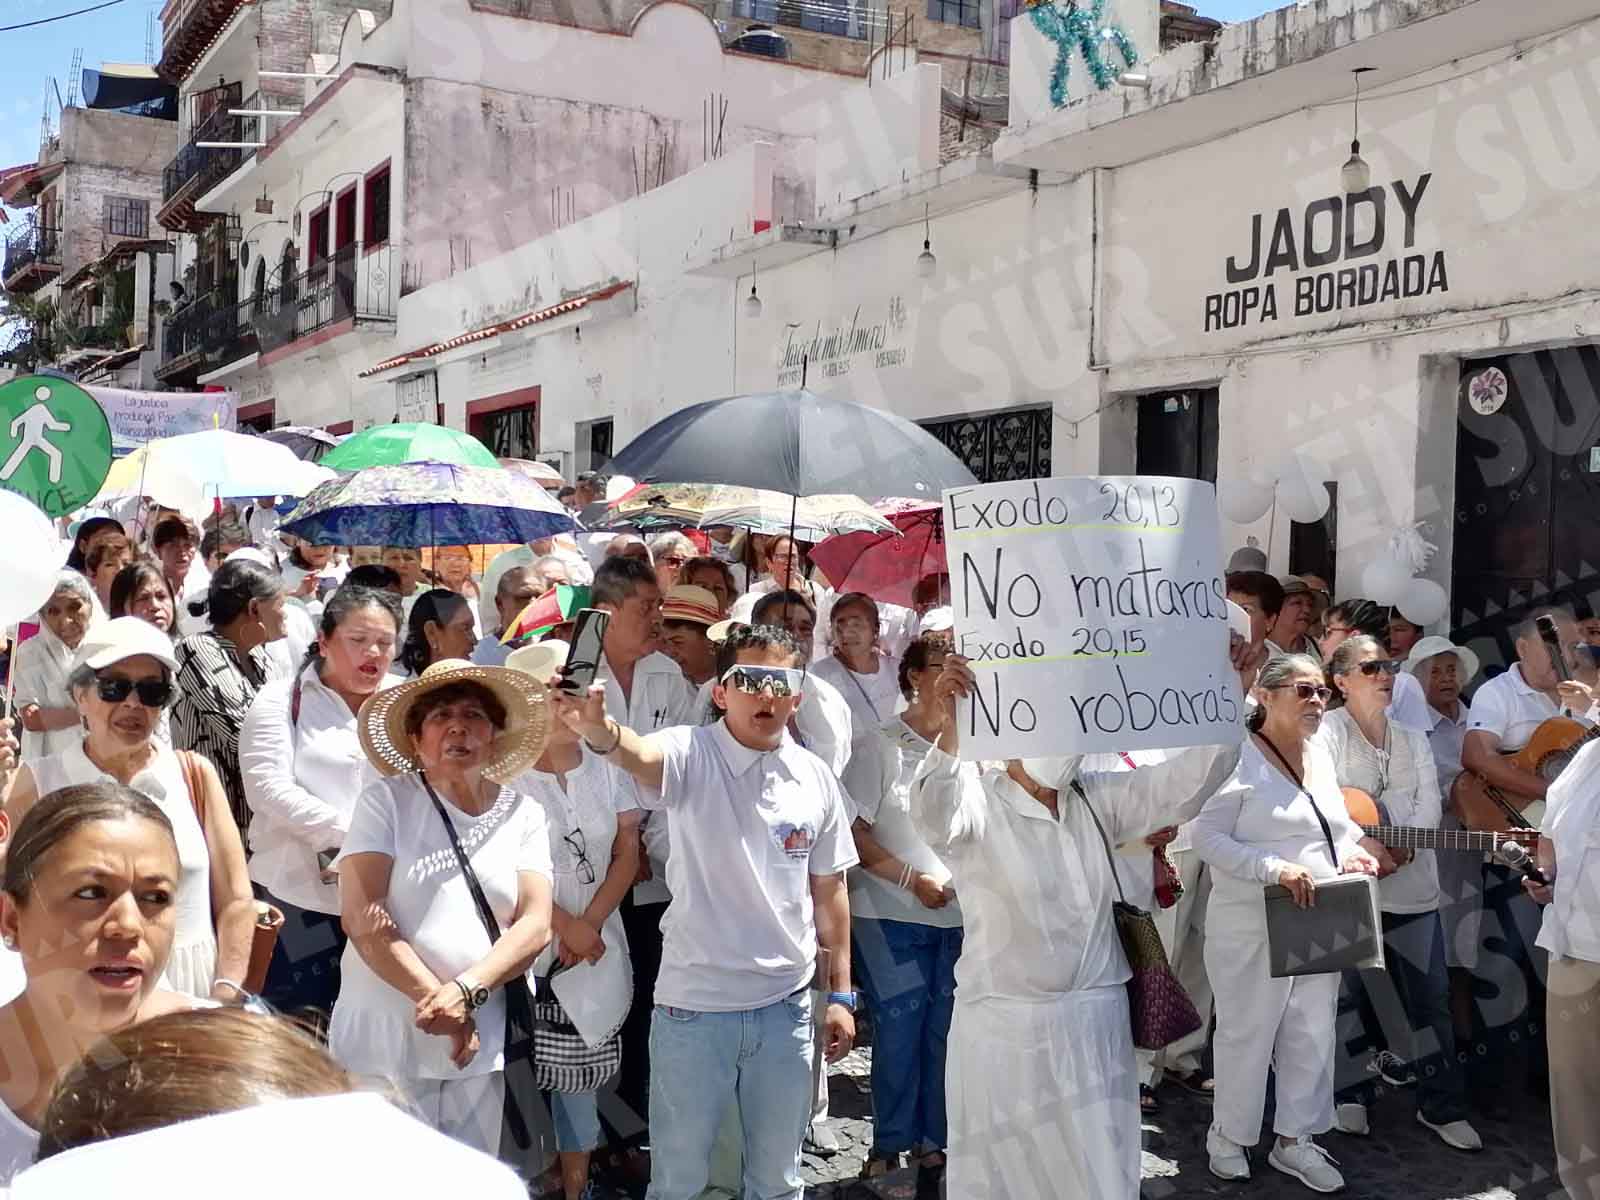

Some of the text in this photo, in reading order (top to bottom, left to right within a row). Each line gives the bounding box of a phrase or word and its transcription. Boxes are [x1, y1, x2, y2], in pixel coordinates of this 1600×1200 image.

[1226, 173, 1432, 283] JAODY
[1204, 251, 1448, 332] ROPA BORDADA
[950, 482, 1179, 530] Exodo 20,13
[963, 547, 1041, 619] No
[960, 626, 1147, 661] Exodo 20,15
[971, 672, 1037, 736] No
